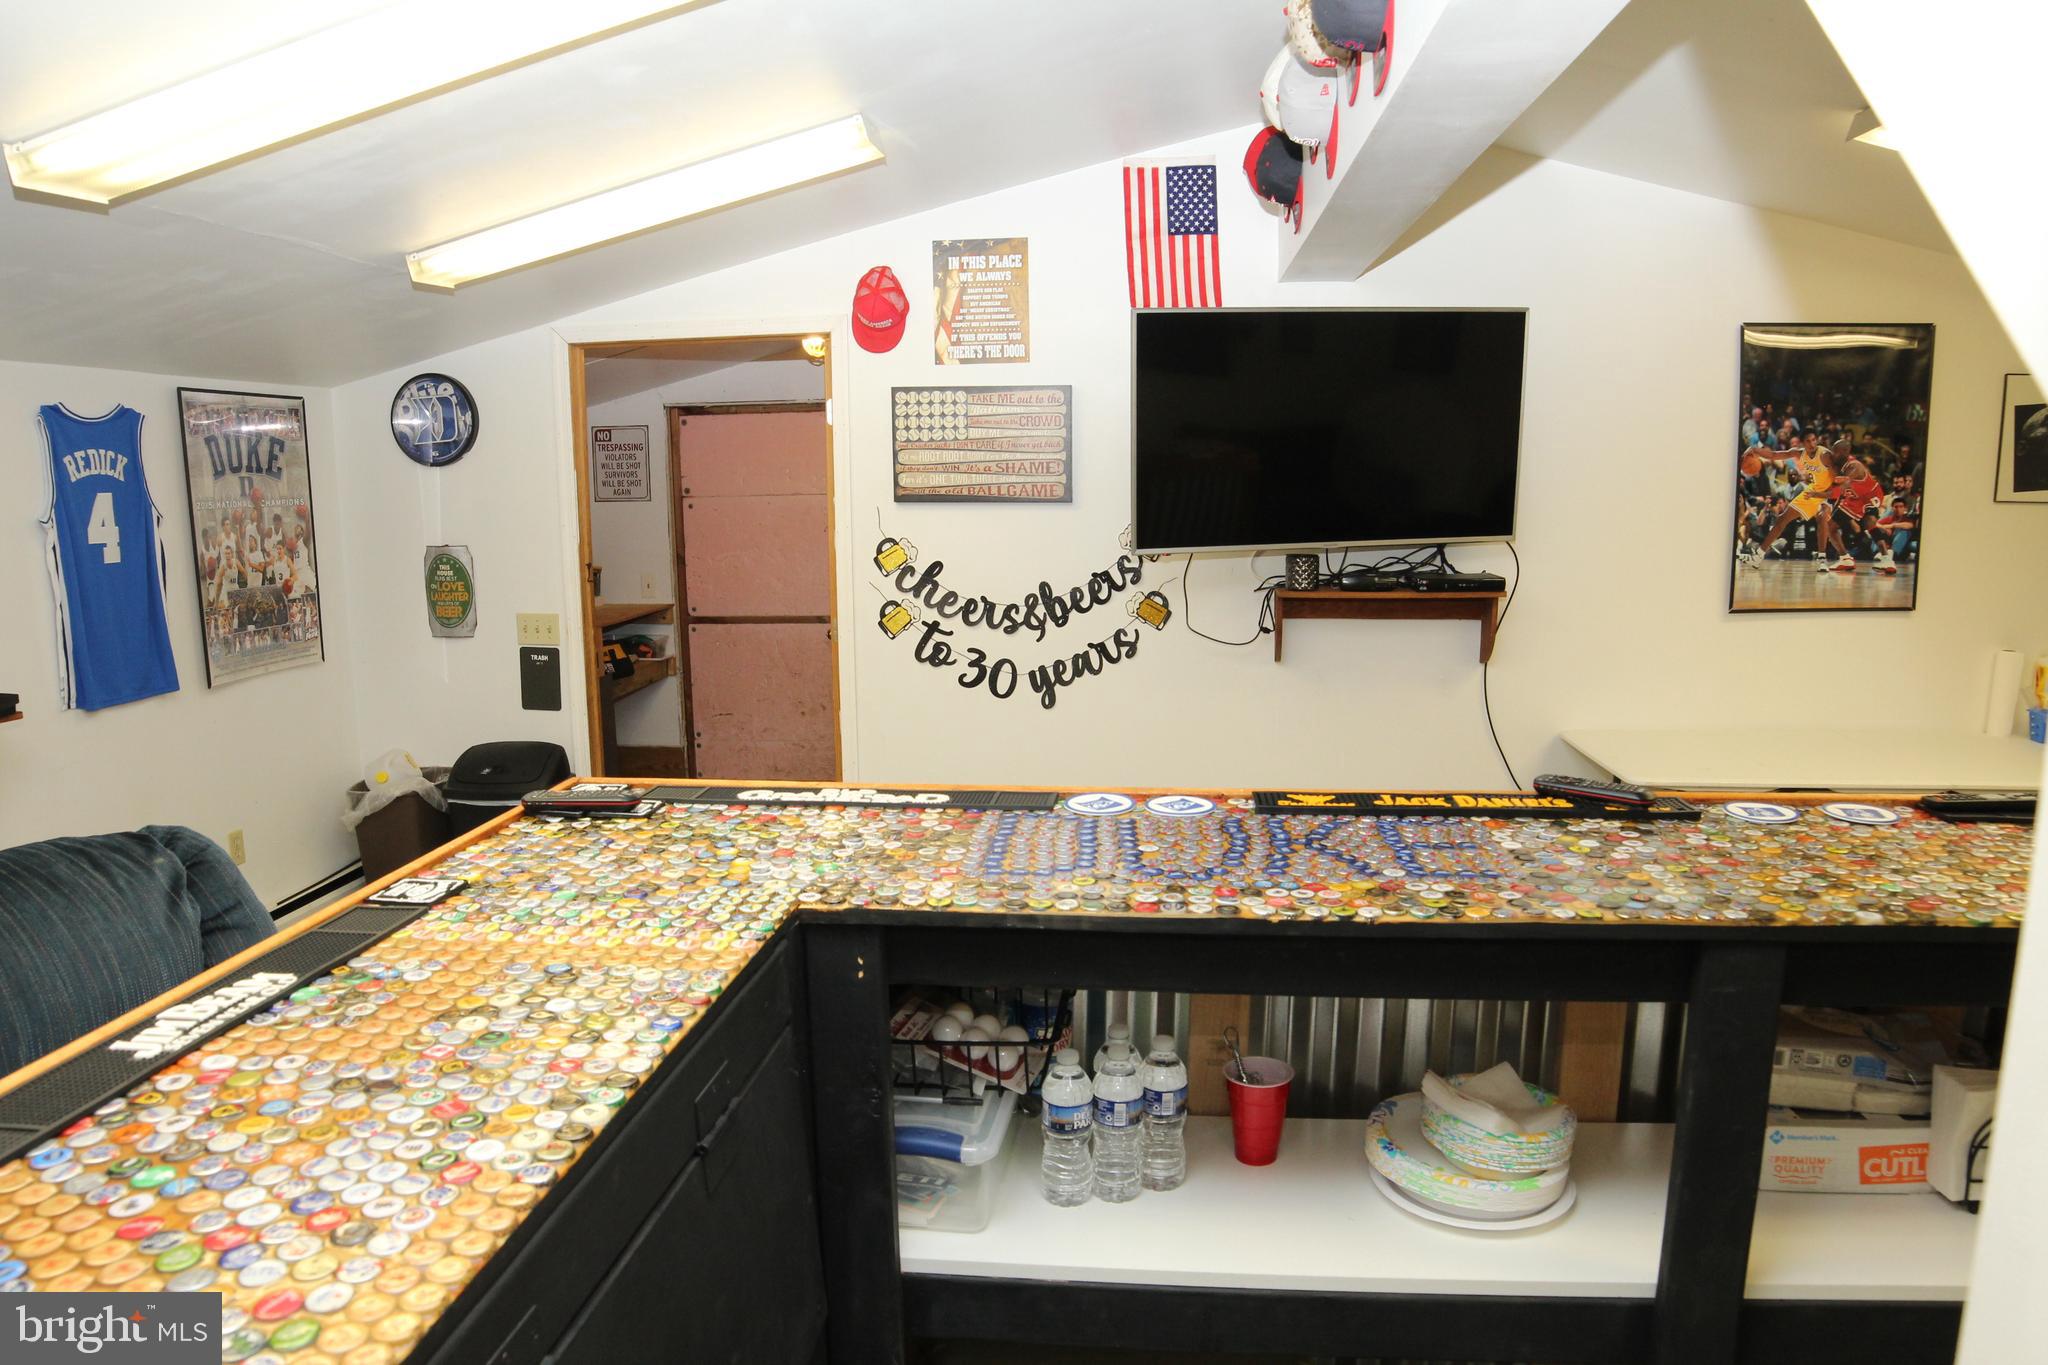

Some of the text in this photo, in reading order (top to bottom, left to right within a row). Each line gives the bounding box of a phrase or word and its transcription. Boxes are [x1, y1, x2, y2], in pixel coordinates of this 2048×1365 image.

[948, 254, 1023, 270] IN THIS PLACE
[959, 270, 1012, 282] WE ALWAYS
[959, 333, 976, 342] THIS
[976, 332, 1007, 341] OFFENDS
[1008, 332, 1022, 340] YOU
[947, 343, 1025, 359] THERE'S THE DOOR
[971, 393, 1062, 405] TAKE ME out to the
[1019, 415, 1062, 427] CROWD
[597, 431, 610, 441] NO
[597, 443, 644, 452] TRESPASSING
[975, 439, 998, 449] CARE
[203, 431, 286, 480] DUKE
[604, 453, 637, 461] VIOLATORS
[62, 448, 128, 483] REDICK
[601, 462, 615, 470] WILL
[626, 462, 641, 470] SHOT
[941, 464, 961, 472] WIN
[964, 463, 981, 472] It's
[995, 461, 1061, 475] SHAME!
[604, 471, 638, 479] SURVIVORS
[601, 480, 616, 488] WILL
[626, 479, 642, 487] SHOT
[613, 488, 632, 496] AGAIN
[216, 500, 253, 509] NATIONAL
[261, 497, 305, 508] CHAMPIONS
[87, 492, 122, 564] 4
[437, 581, 465, 592] LOVE
[431, 591, 470, 602] LAUGHTER
[435, 605, 463, 618] BEER
[914, 619, 1140, 710] to 30 years
[1373, 794, 1574, 808] JACK DANIEL'S
[1775, 1155, 1825, 1166] PREMIUM
[1774, 1165, 1825, 1175] QUALITY
[1863, 1156, 1927, 1178] CUTL
